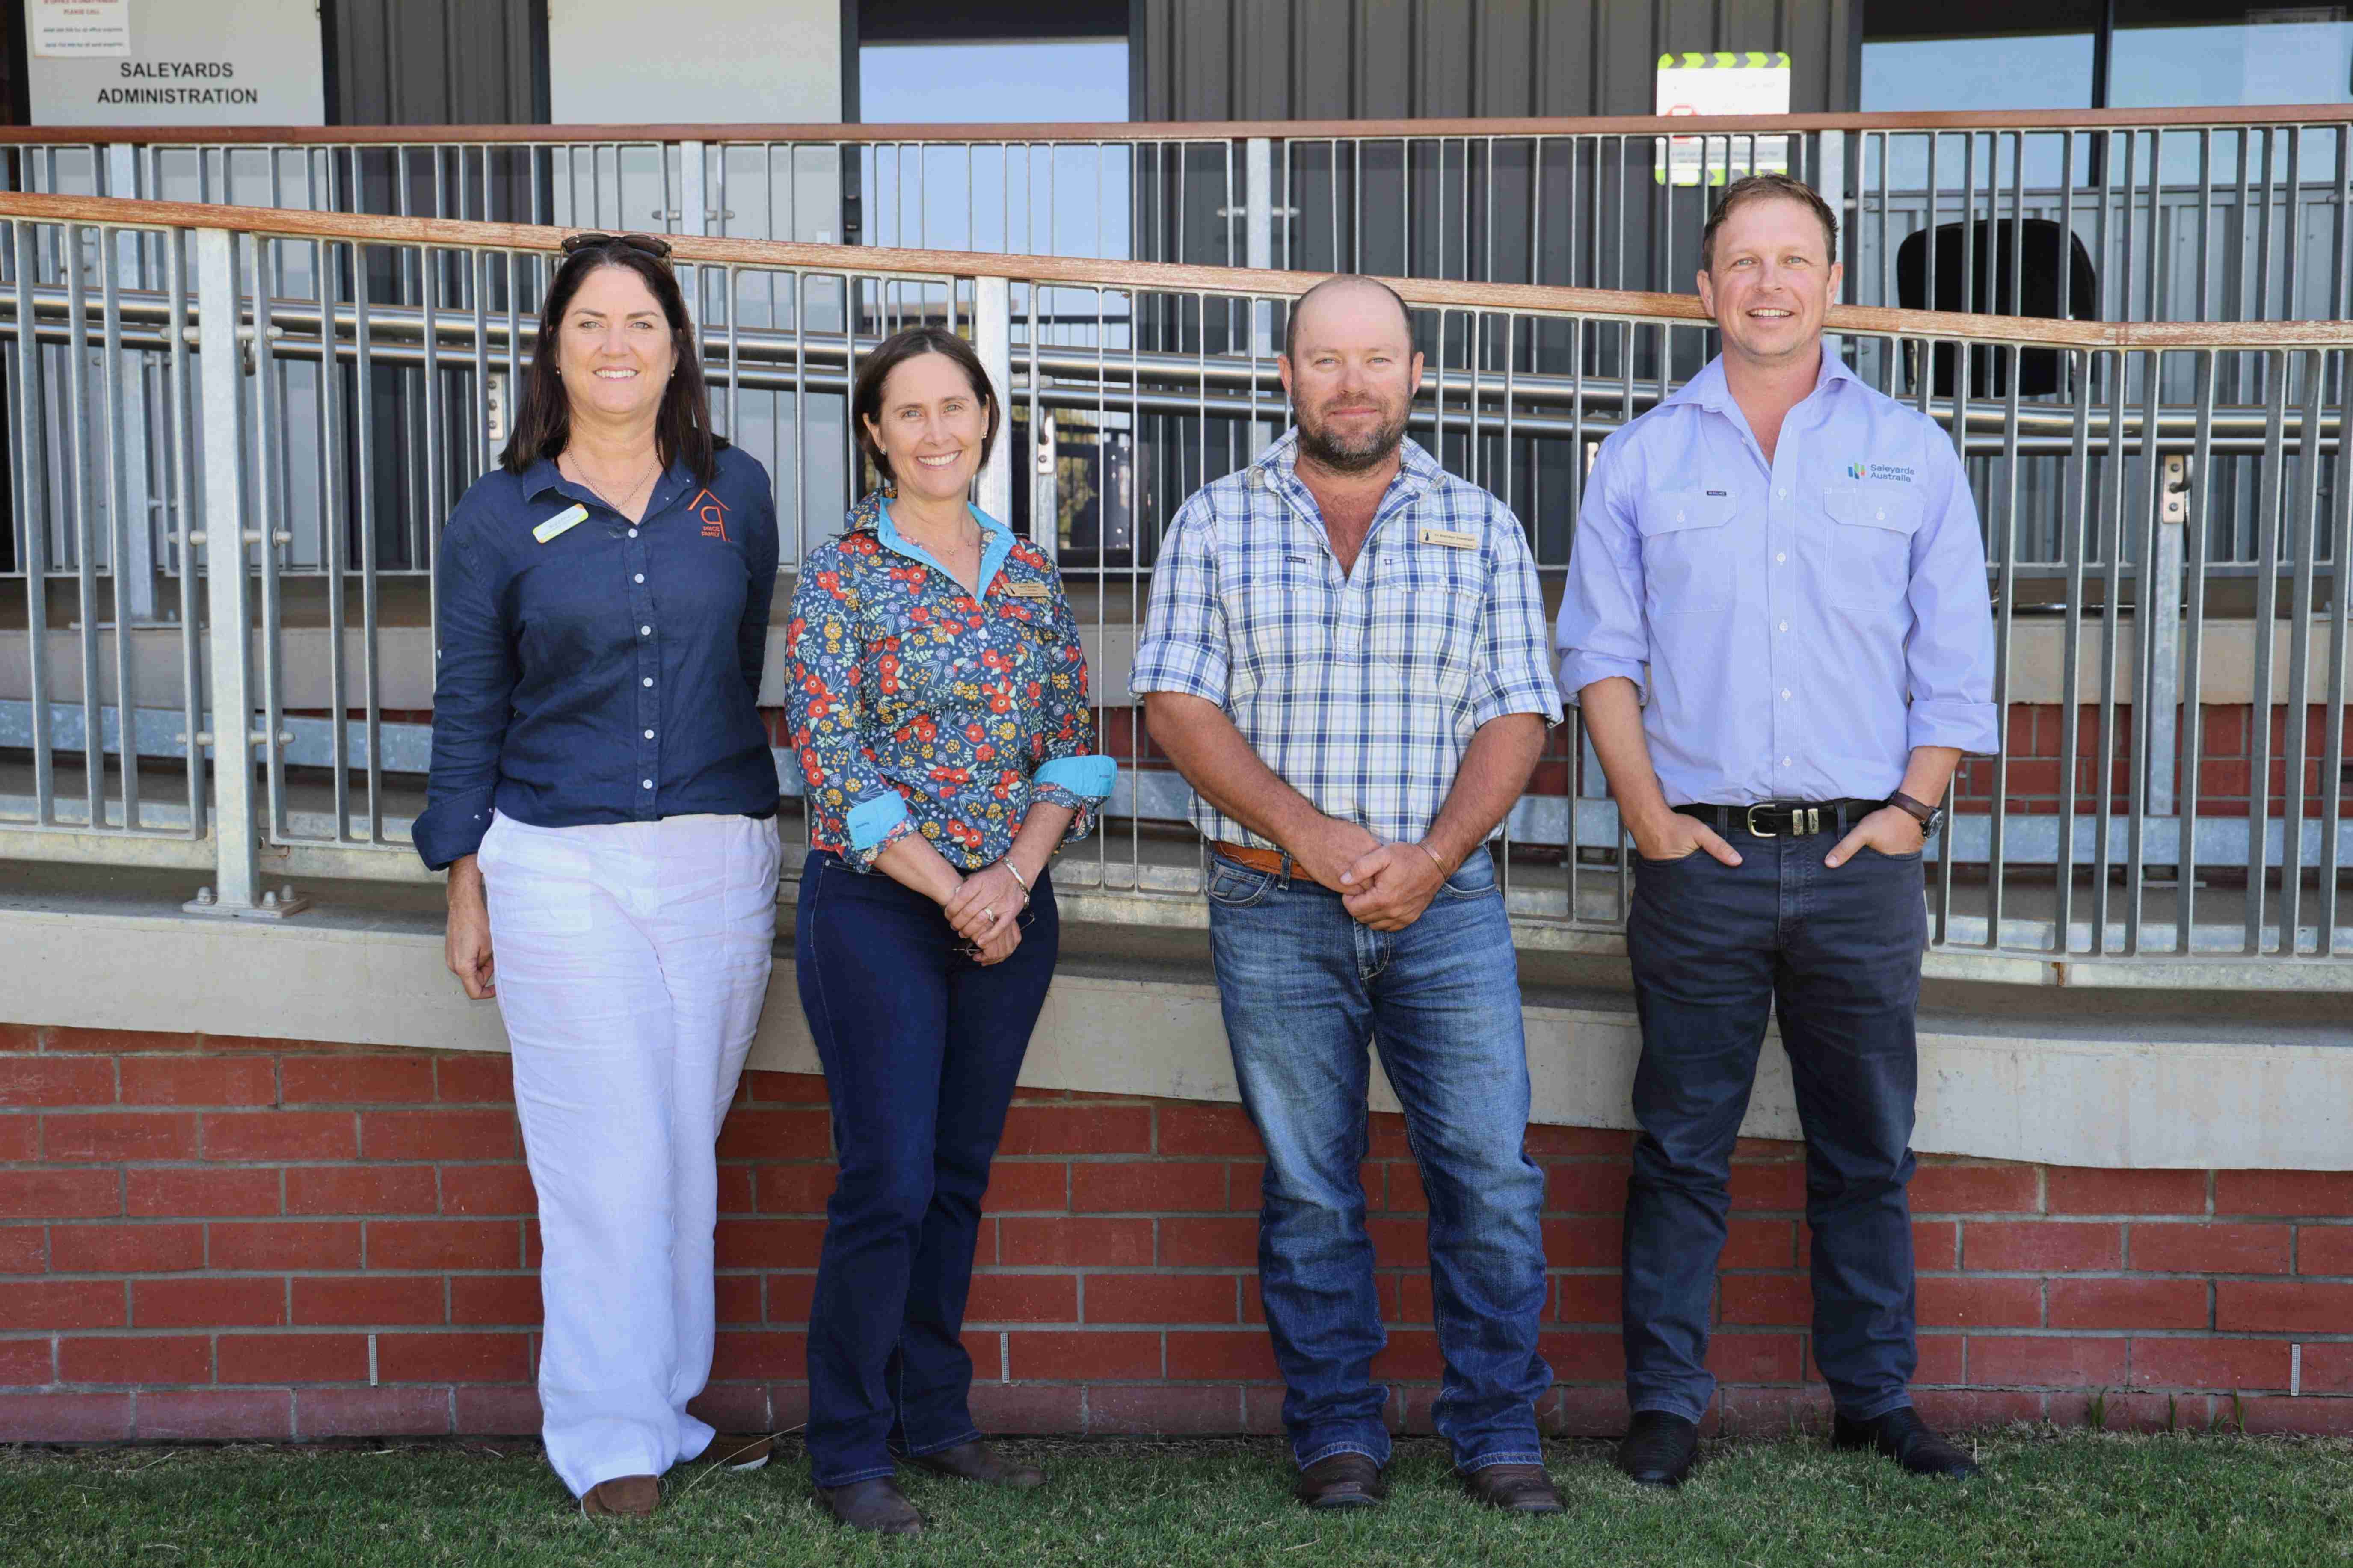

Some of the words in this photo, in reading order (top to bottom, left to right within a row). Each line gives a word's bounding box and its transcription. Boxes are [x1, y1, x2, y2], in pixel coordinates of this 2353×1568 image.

[121, 62, 234, 78] SALEYARDS
[98, 89, 258, 104] ADMINISTRATION
[1870, 464, 1915, 475] Saleyards
[1871, 472, 1911, 482] Australia
